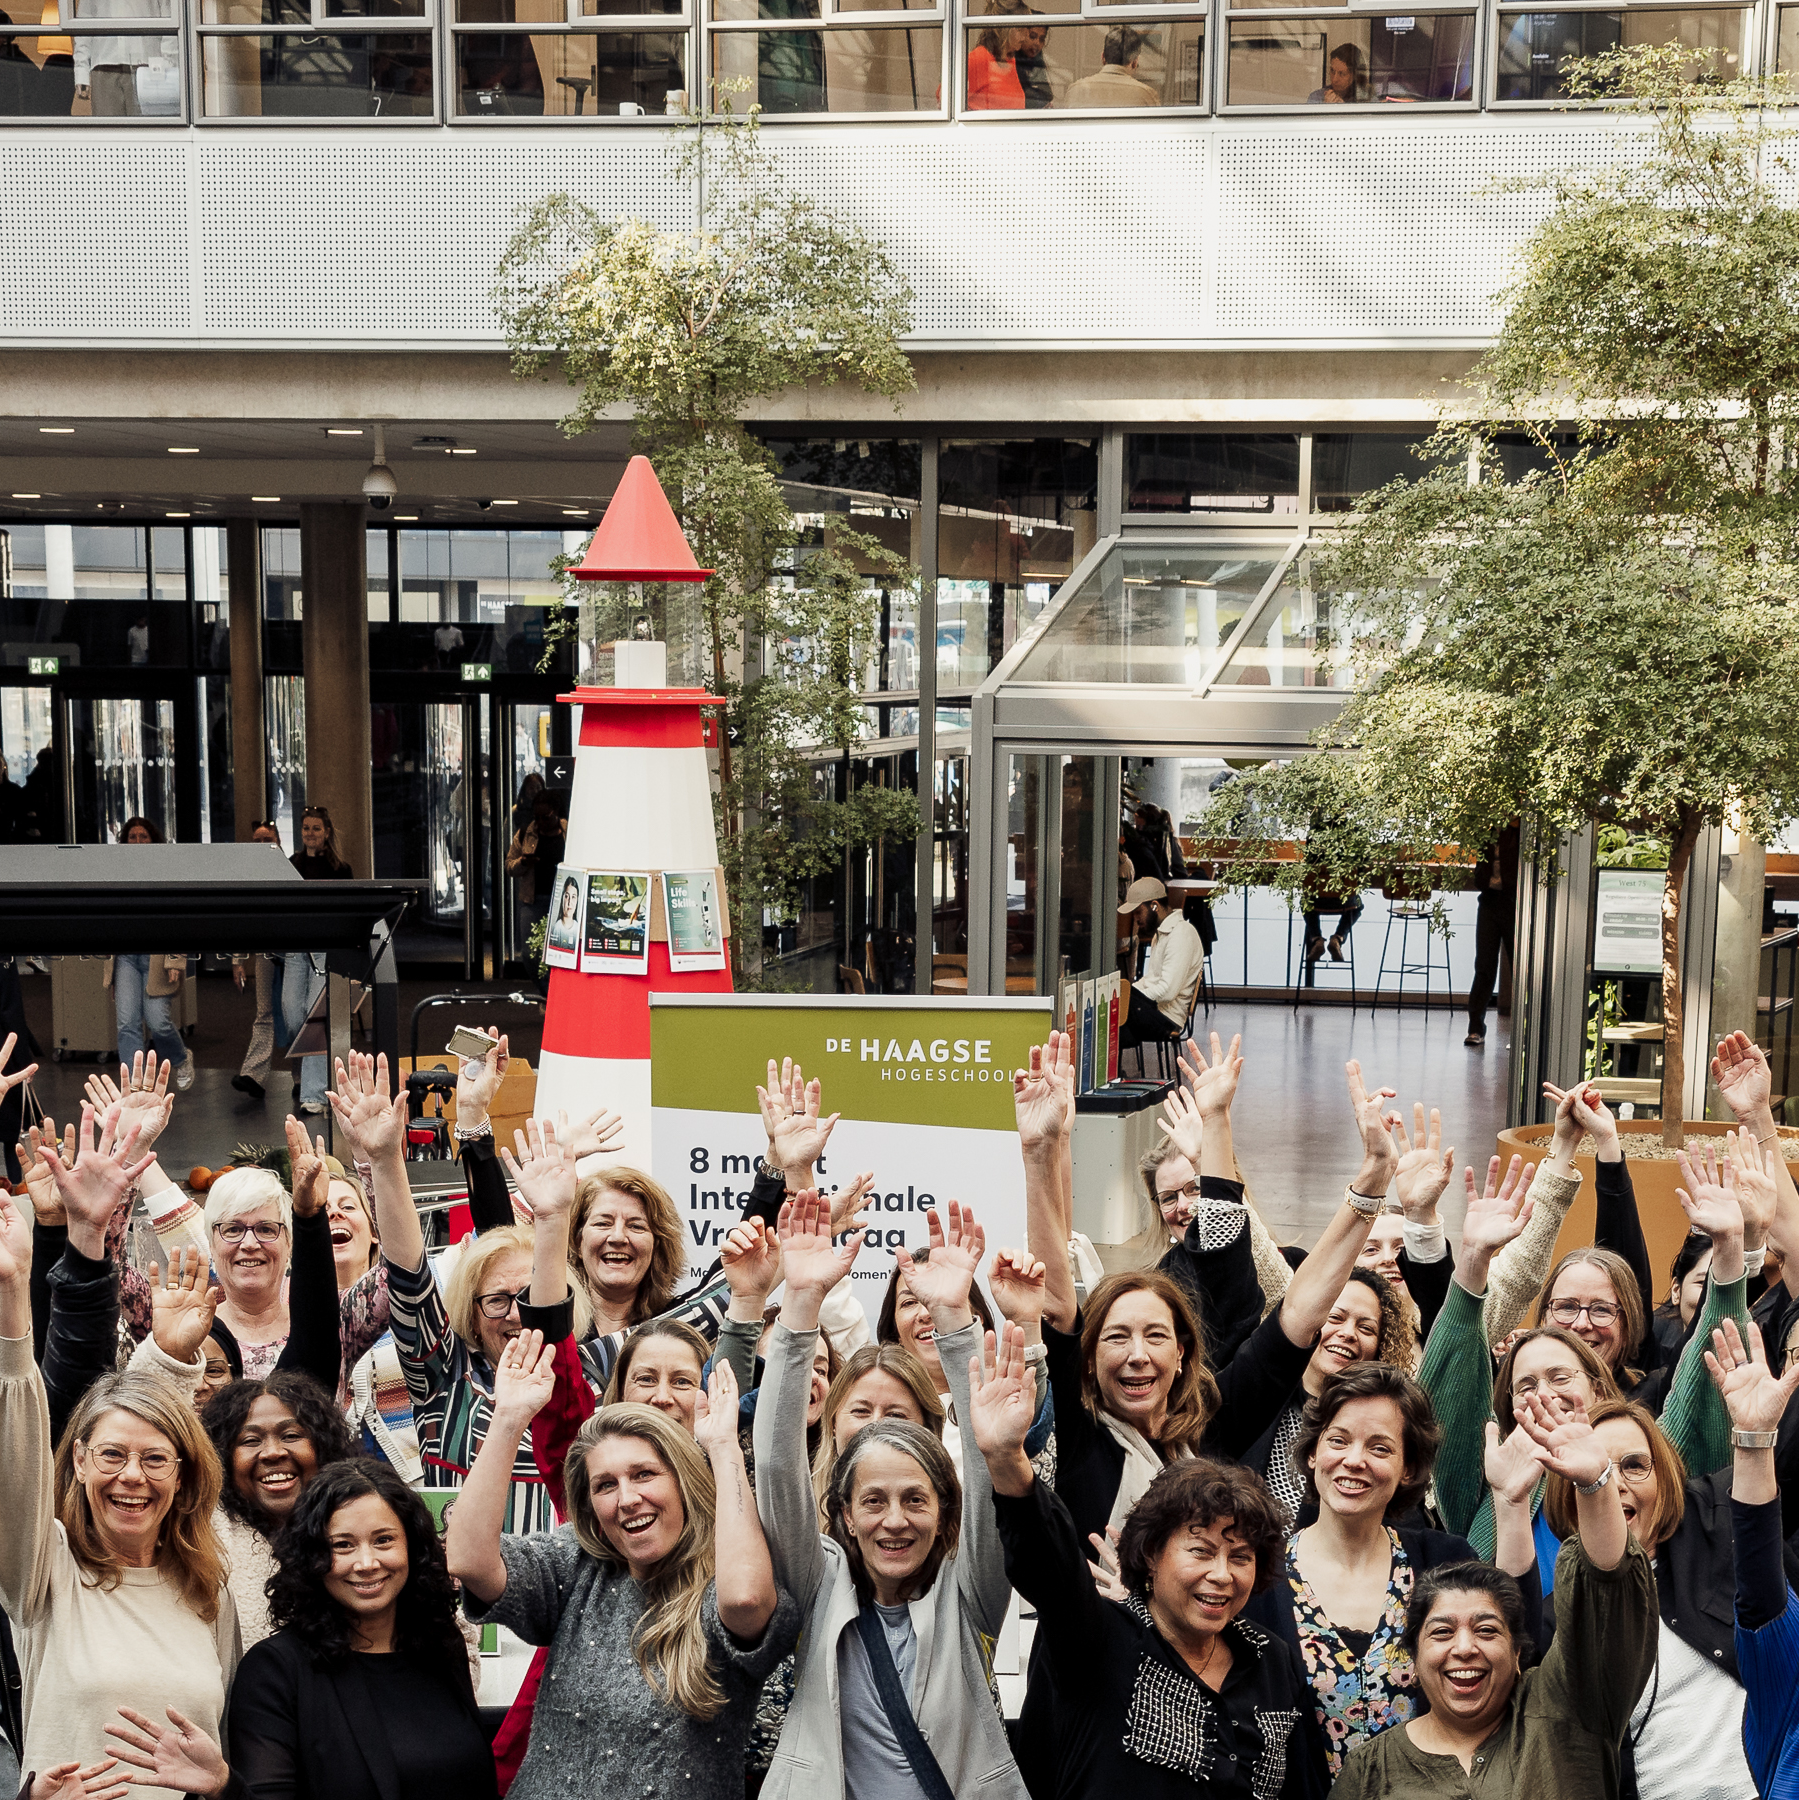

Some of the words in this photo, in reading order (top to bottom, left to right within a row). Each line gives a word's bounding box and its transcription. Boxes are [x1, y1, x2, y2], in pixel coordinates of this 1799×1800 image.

[671, 888, 687, 897] Life
[591, 896, 600, 904] big
[826, 1038, 851, 1052] DE
[860, 1039, 991, 1063] HAAGSE
[881, 1068, 1015, 1082] HOGESCHOOL
[689, 1147, 709, 1174] 8
[721, 1152, 827, 1174] mat
